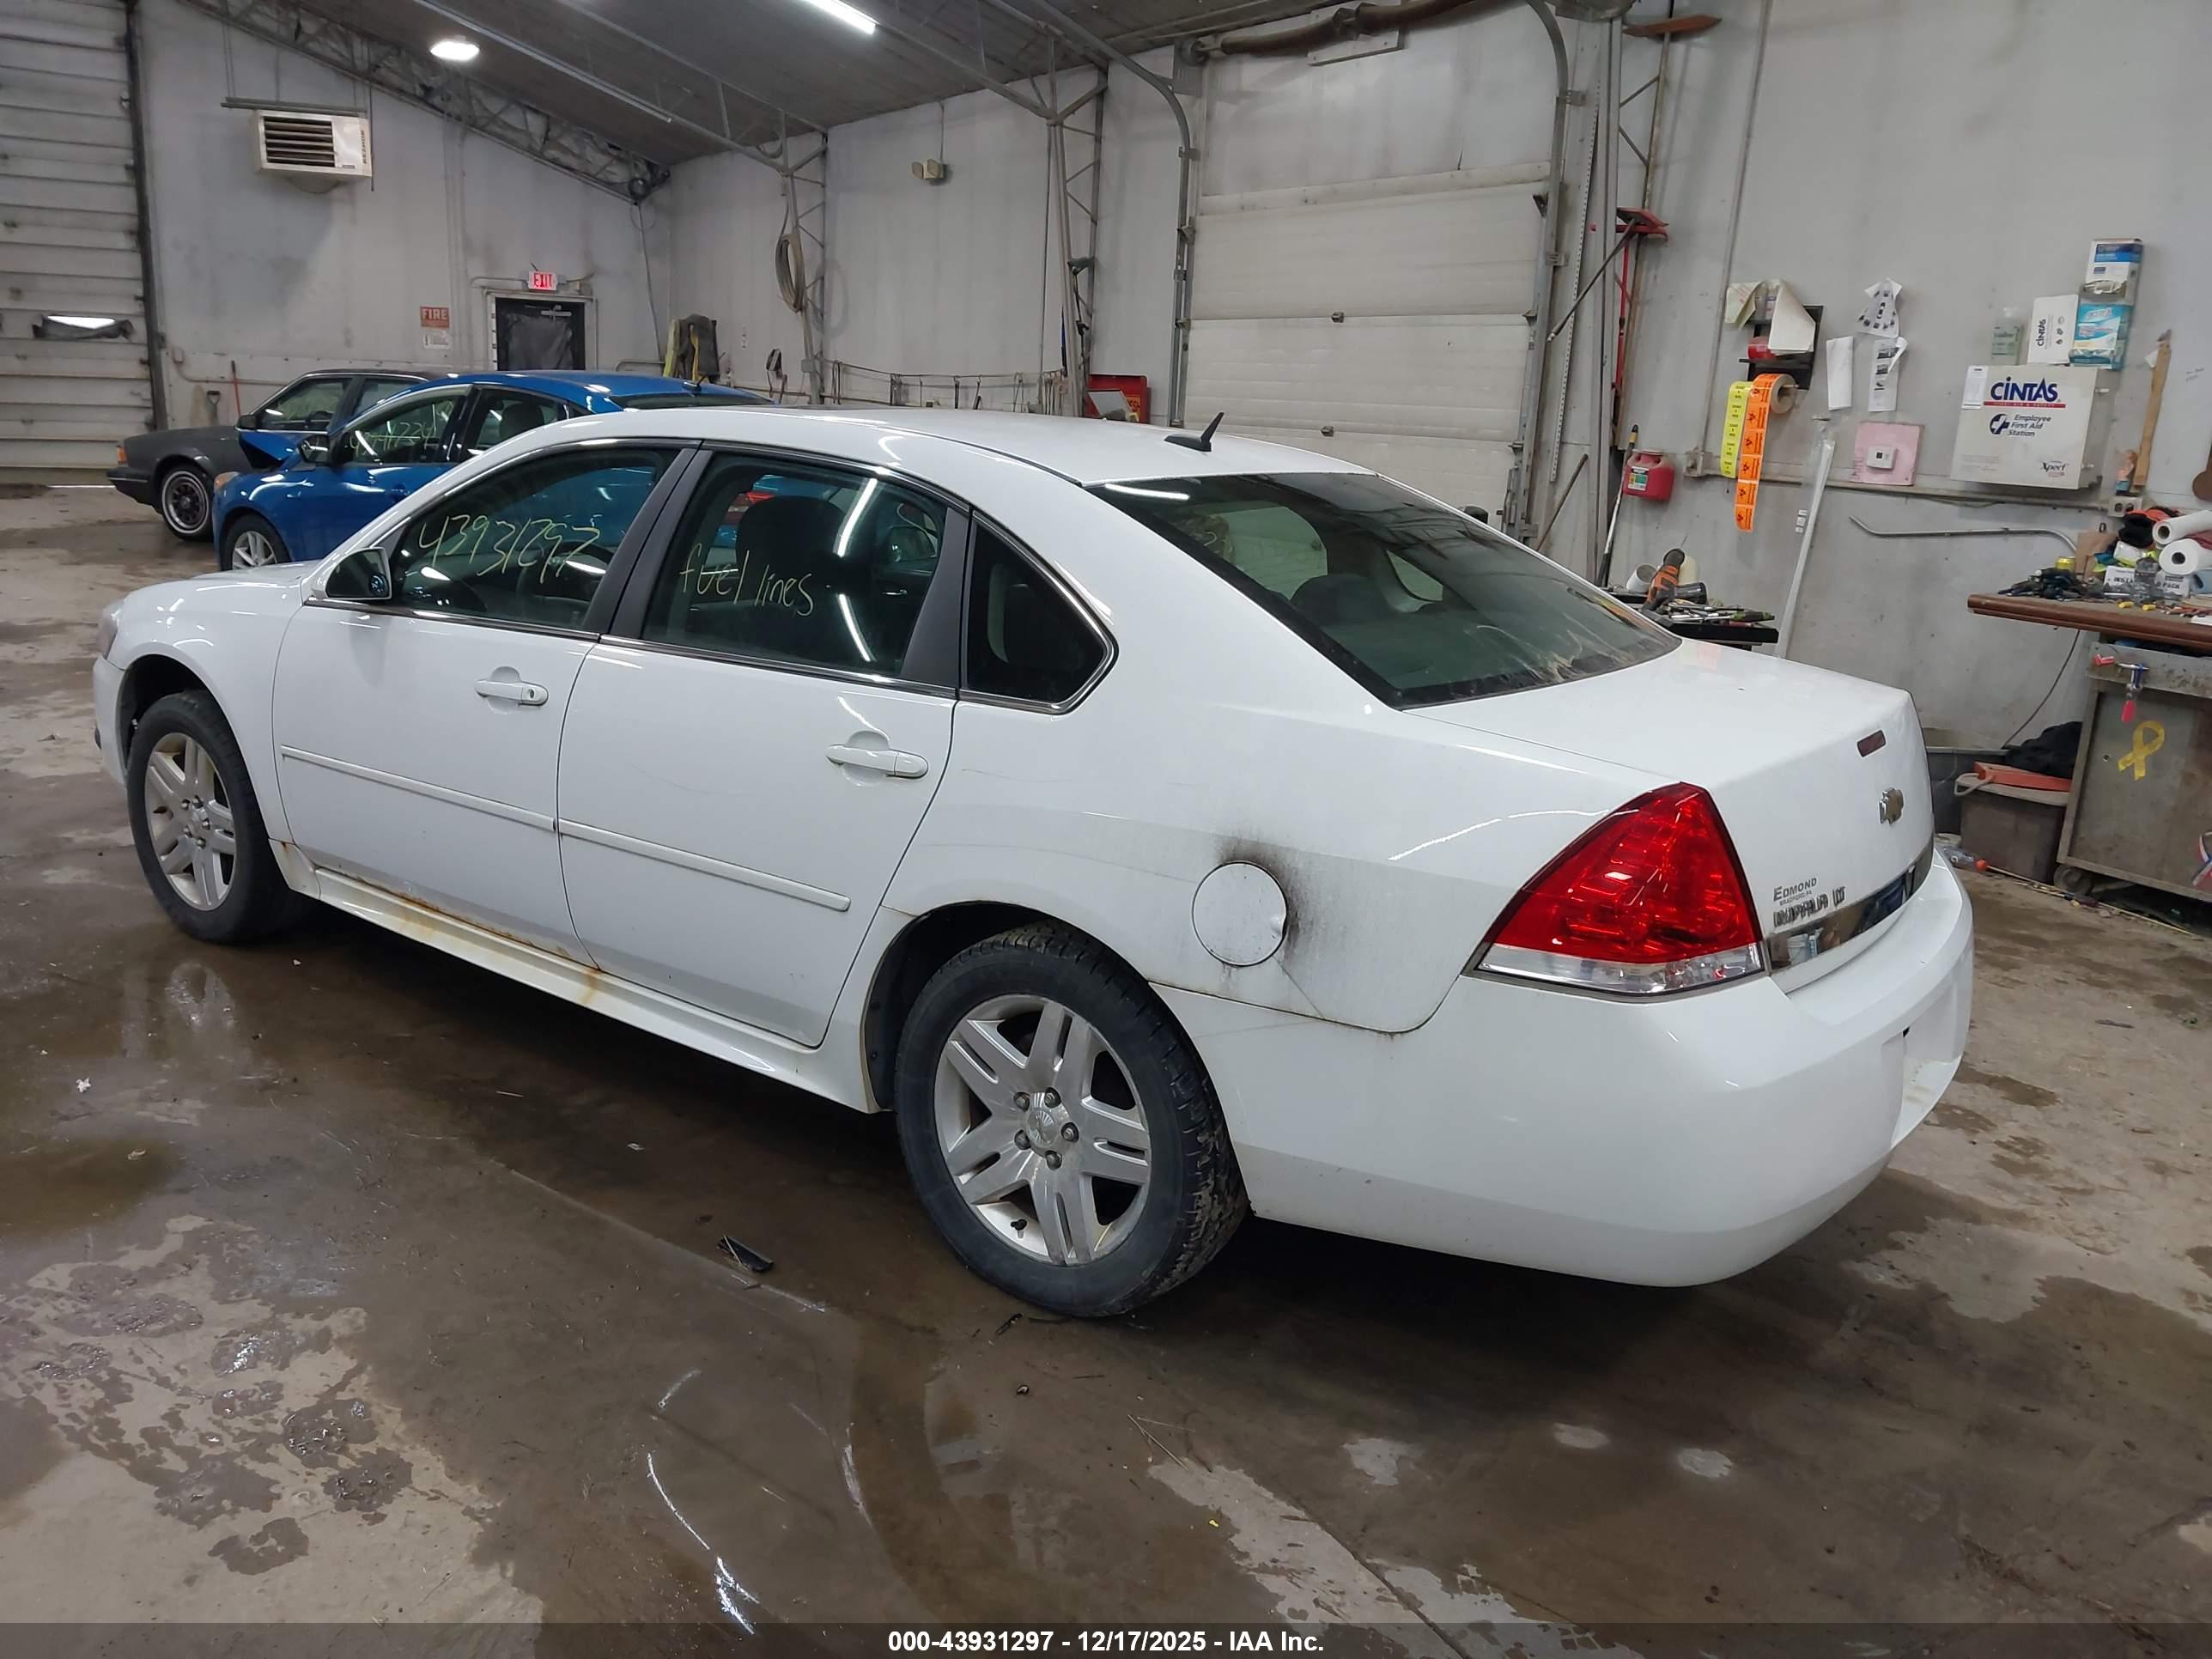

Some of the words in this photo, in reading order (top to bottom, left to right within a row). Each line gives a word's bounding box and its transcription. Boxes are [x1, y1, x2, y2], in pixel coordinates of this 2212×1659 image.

[533, 272, 553, 288] EXIT
[422, 308, 447, 319] FIRE
[2014, 414, 2051, 422] Employee
[679, 544, 750, 605] fuel
[755, 564, 813, 617] lines
[1773, 878, 1817, 902] EDMOND
